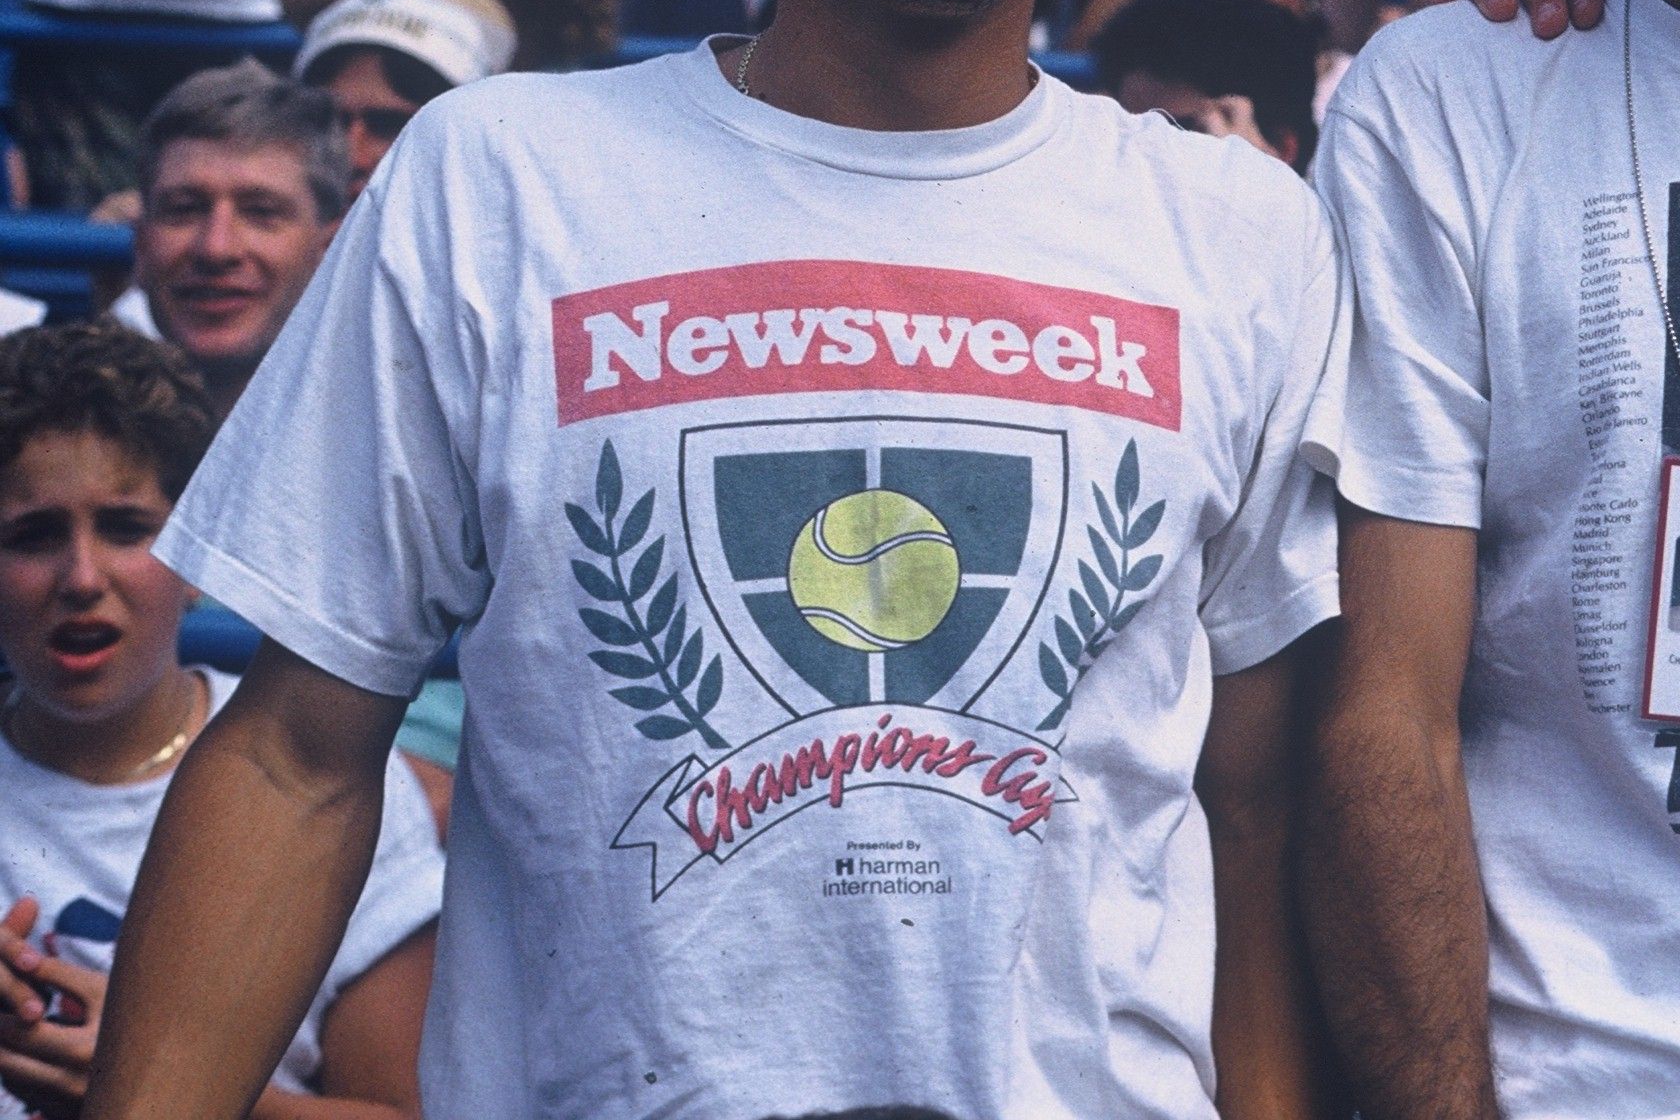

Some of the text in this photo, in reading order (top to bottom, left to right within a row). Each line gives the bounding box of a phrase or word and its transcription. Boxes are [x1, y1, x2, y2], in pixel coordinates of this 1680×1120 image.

[1583, 205, 1628, 220] Adelaide
[1583, 220, 1617, 234] Sydney
[1583, 228, 1630, 245] Auckland
[1582, 247, 1611, 260] Milan
[1581, 263, 1599, 273] San
[1580, 284, 1619, 300] Toronto
[1579, 296, 1620, 315] Brussels
[1579, 307, 1644, 328] Philadelphia
[1578, 323, 1620, 341] Stuttgart
[583, 300, 1155, 398] Newsweek
[1578, 337, 1627, 355] Memphis
[1612, 361, 1642, 372] Wells
[1578, 377, 1636, 396] Casablanca
[1582, 404, 1620, 423] Orlando
[1585, 426, 1602, 436] Rio
[1579, 498, 1639, 512] onte Carlo
[1604, 513, 1632, 524] Kong
[1573, 527, 1609, 539] Madrid
[1572, 541, 1612, 553] Munich
[1571, 555, 1623, 568] Singapore
[1571, 567, 1620, 580] Hamburg
[1571, 580, 1627, 594] Charleston
[687, 713, 997, 854] Champions
[846, 840, 921, 851] Presented By
[859, 857, 940, 875] harman
[822, 876, 952, 897] international
